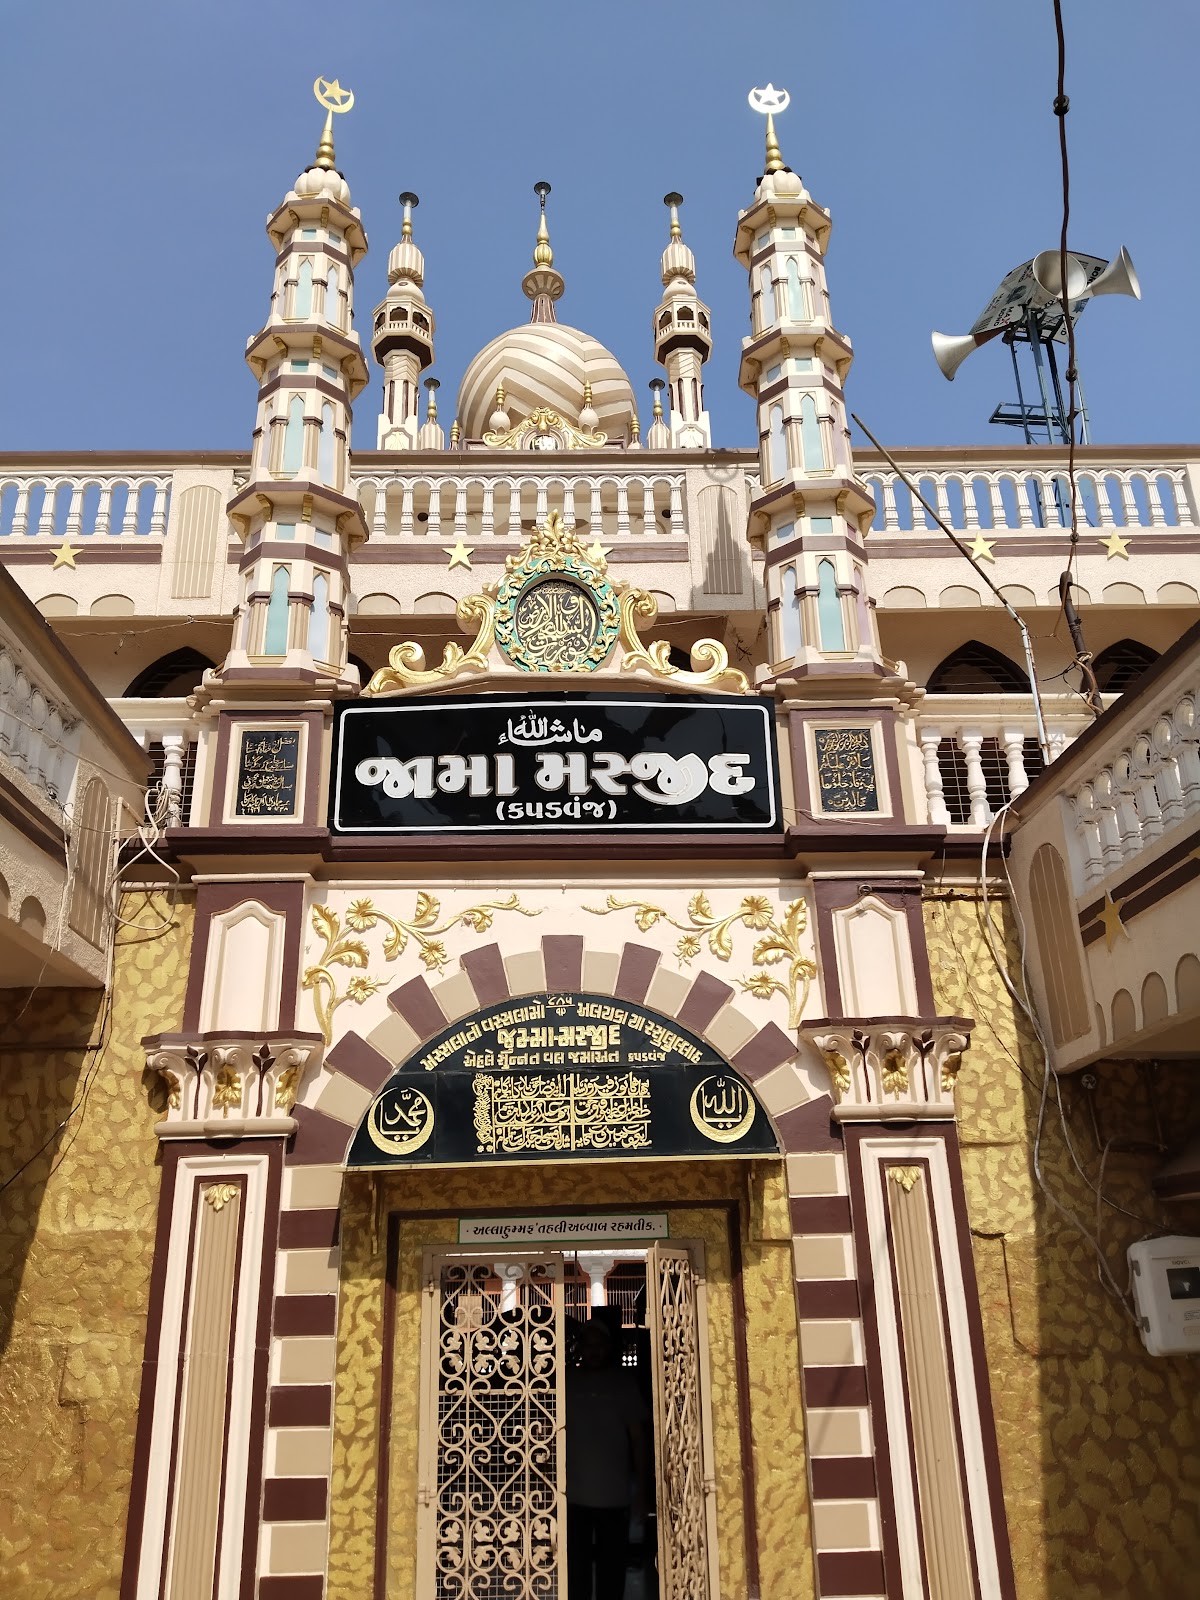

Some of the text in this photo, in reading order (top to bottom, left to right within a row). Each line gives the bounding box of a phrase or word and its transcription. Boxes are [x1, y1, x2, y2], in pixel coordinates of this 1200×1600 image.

[994, 308, 1007, 326] BOND
[1000, 306, 1014, 325] MAX
[355, 754, 519, 799] જામા
[496, 796, 617, 820] (કપડવંજ)
[628, 1050, 666, 1063] કપડવંજ
